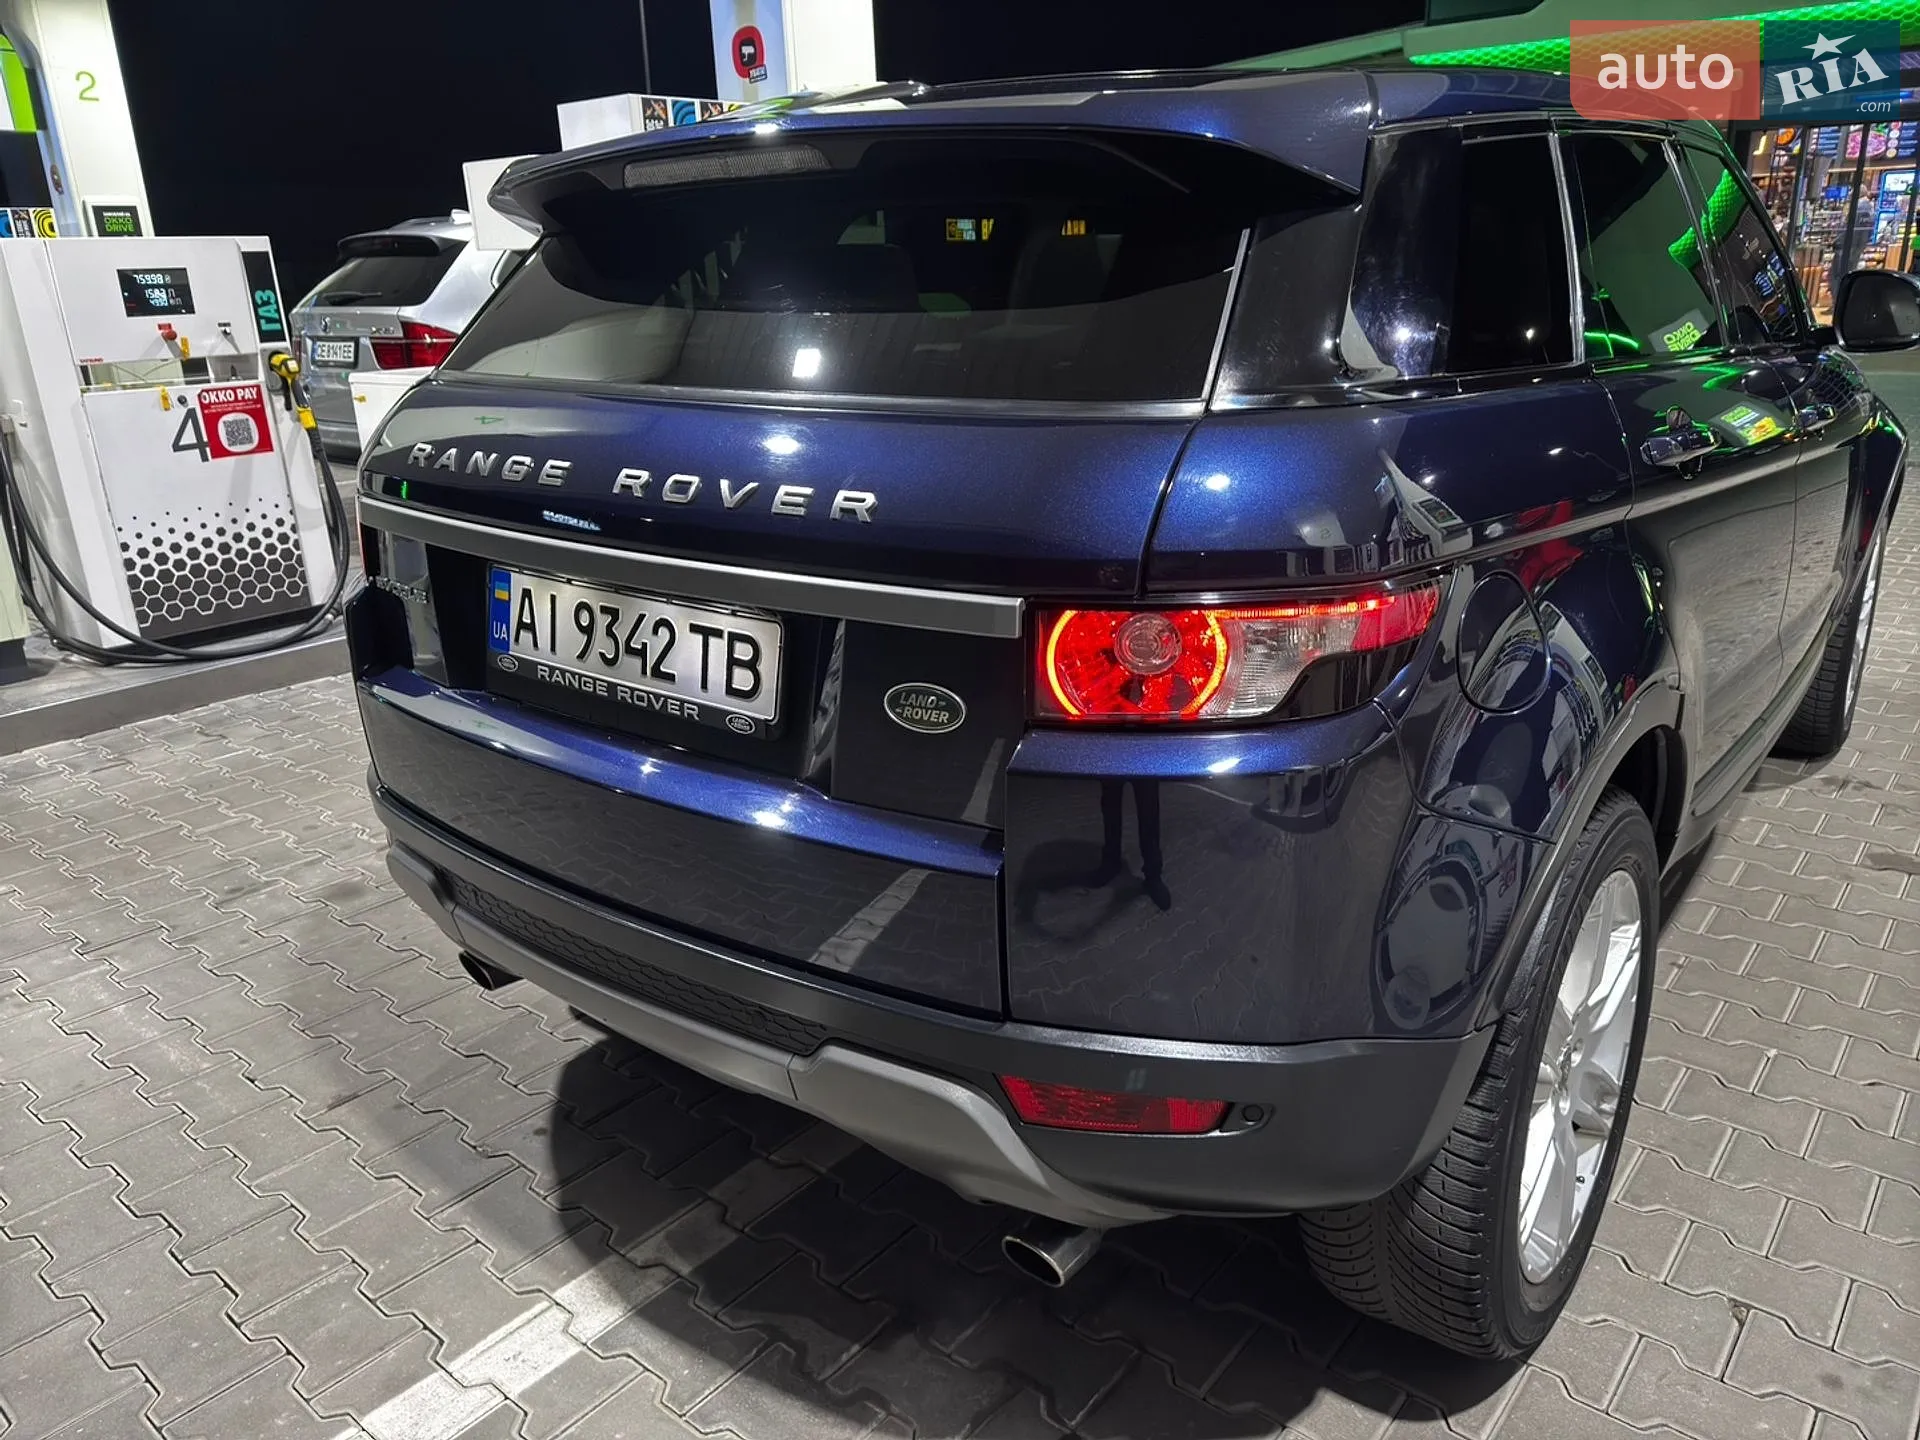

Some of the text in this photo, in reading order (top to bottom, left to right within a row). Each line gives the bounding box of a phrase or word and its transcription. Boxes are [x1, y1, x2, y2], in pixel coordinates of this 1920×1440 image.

[75, 70, 100, 101] 2
[255, 290, 282, 330] ГАЗ
[200, 386, 258, 404] OKKO PAY
[172, 406, 209, 462] 4
[407, 442, 573, 487] RANGE
[612, 467, 878, 523] ROVER
[493, 620, 508, 641] UA
[513, 587, 762, 700] AI 9342 TB
[537, 664, 700, 721] RANGE ROVER
